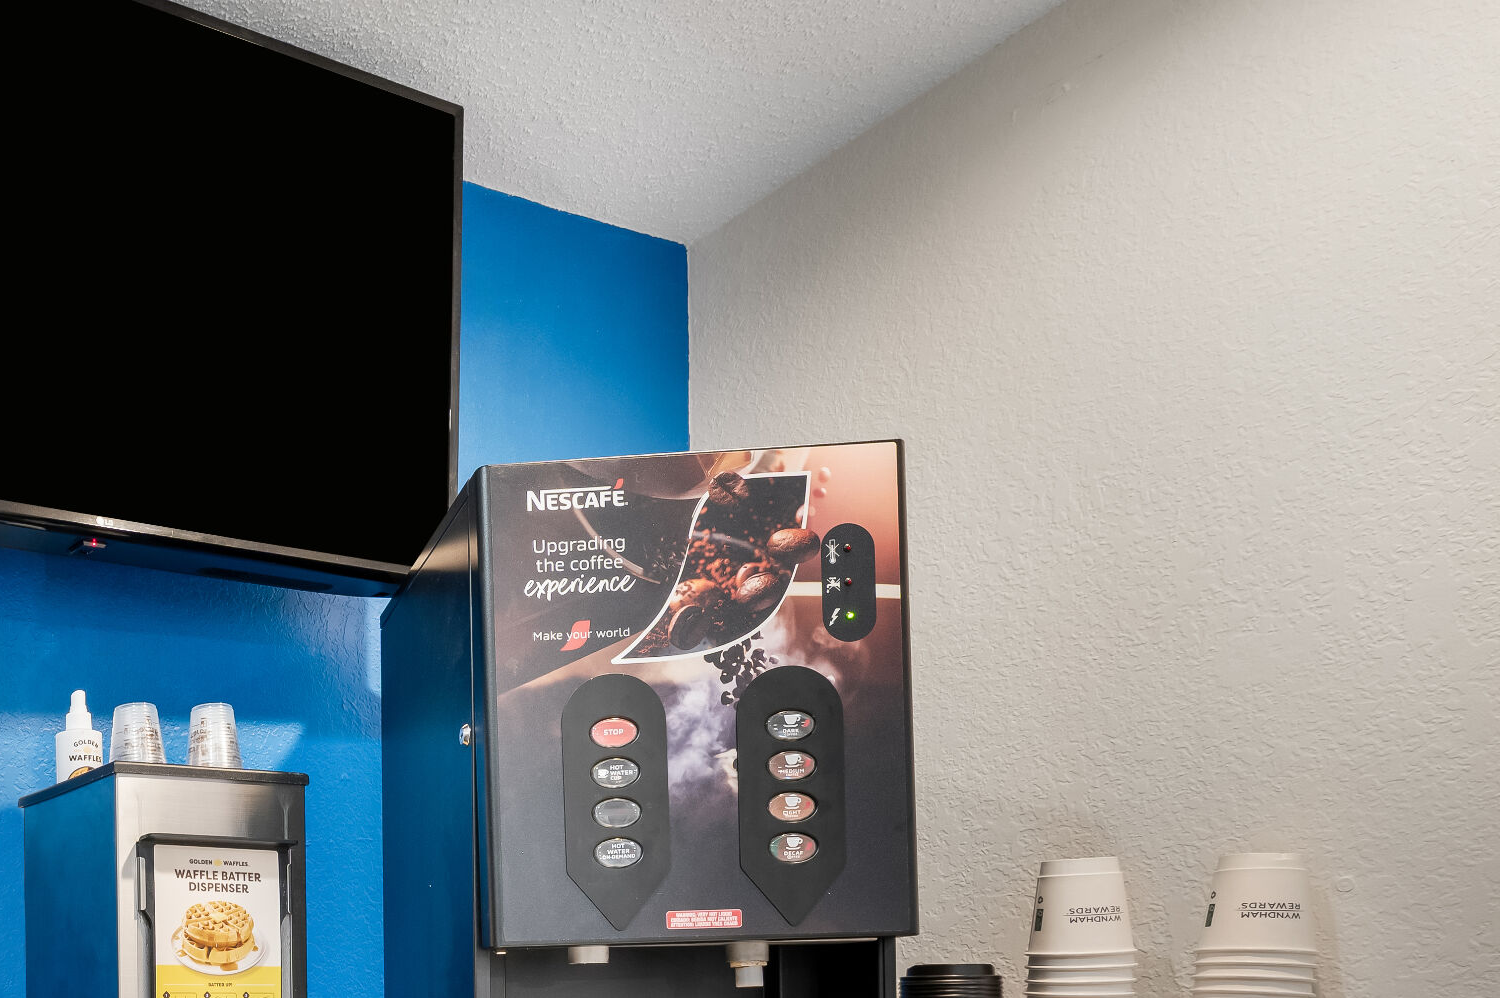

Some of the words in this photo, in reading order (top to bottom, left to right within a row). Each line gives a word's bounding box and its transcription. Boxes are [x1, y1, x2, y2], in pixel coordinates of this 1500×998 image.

[526, 478, 625, 512] NESCAFÉ
[533, 535, 626, 556] Upgrading
[536, 558, 565, 573] the
[570, 555, 623, 571] coffee
[523, 573, 637, 602] experience
[533, 630, 563, 642] Make
[566, 630, 593, 642] your
[596, 627, 630, 639] world
[73, 739, 99, 748] GOLDEN
[68, 754, 102, 763] WAFFLES
[189, 858, 213, 866] GOLDEN
[174, 868, 219, 881] WAFFLE
[221, 870, 262, 883] BATTER
[188, 881, 250, 894] DISPENSER
[1069, 905, 1121, 915] REWARDS
[1241, 902, 1301, 910] REWARDS
[1069, 915, 1122, 924] WYNDHAM
[1240, 911, 1301, 920] WYNDHAM
